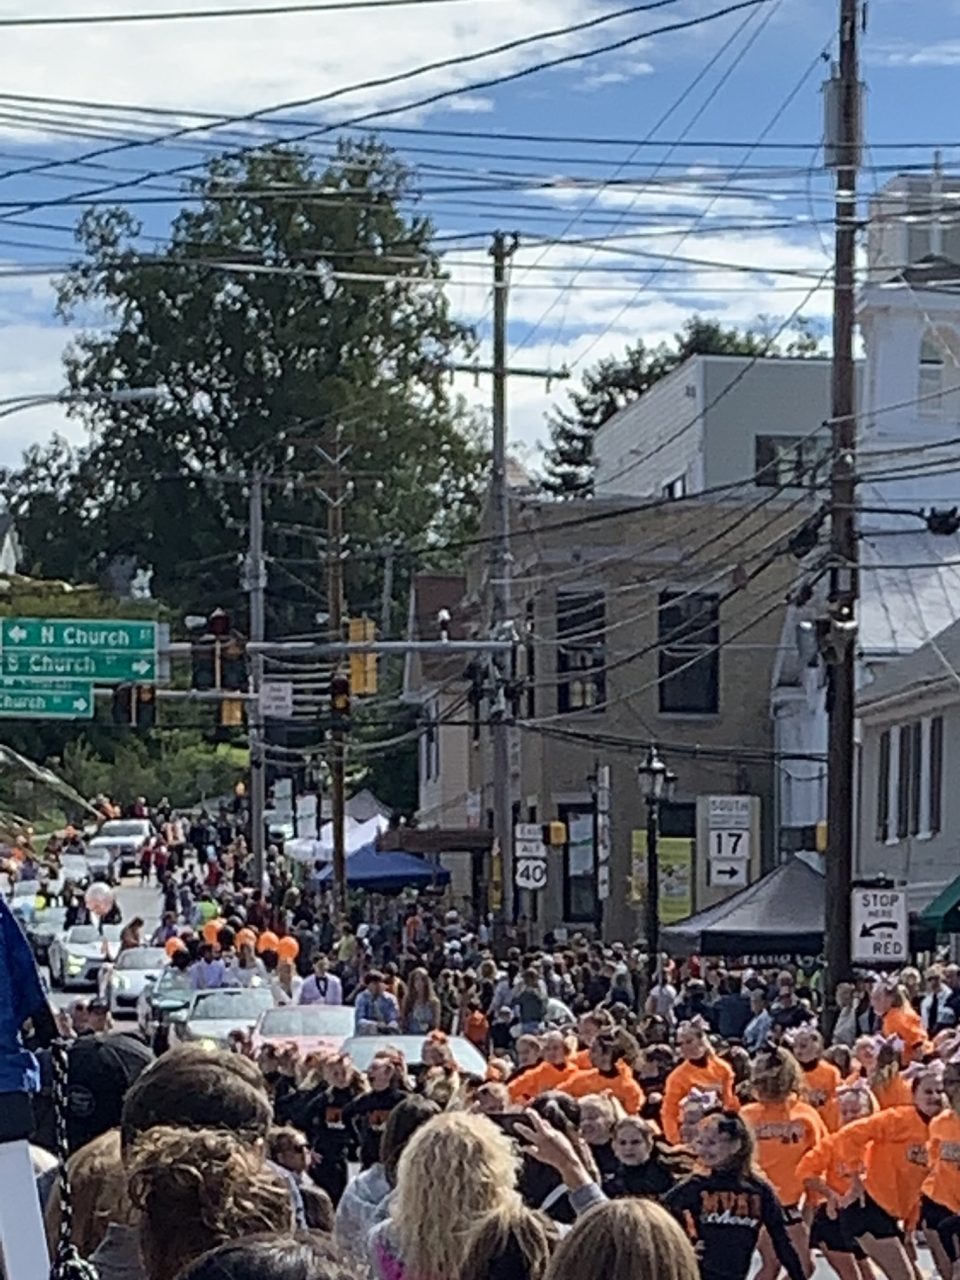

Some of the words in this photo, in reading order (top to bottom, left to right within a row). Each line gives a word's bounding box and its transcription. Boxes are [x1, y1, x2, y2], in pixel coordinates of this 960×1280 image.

[41, 626, 54, 644] N
[63, 626, 129, 646] Church
[8, 653, 19, 672] S
[29, 654, 96, 673] Church
[716, 832, 744, 855] 17
[519, 864, 545, 884] 40
[862, 894, 900, 908] STOP
[872, 941, 903, 955] RED
